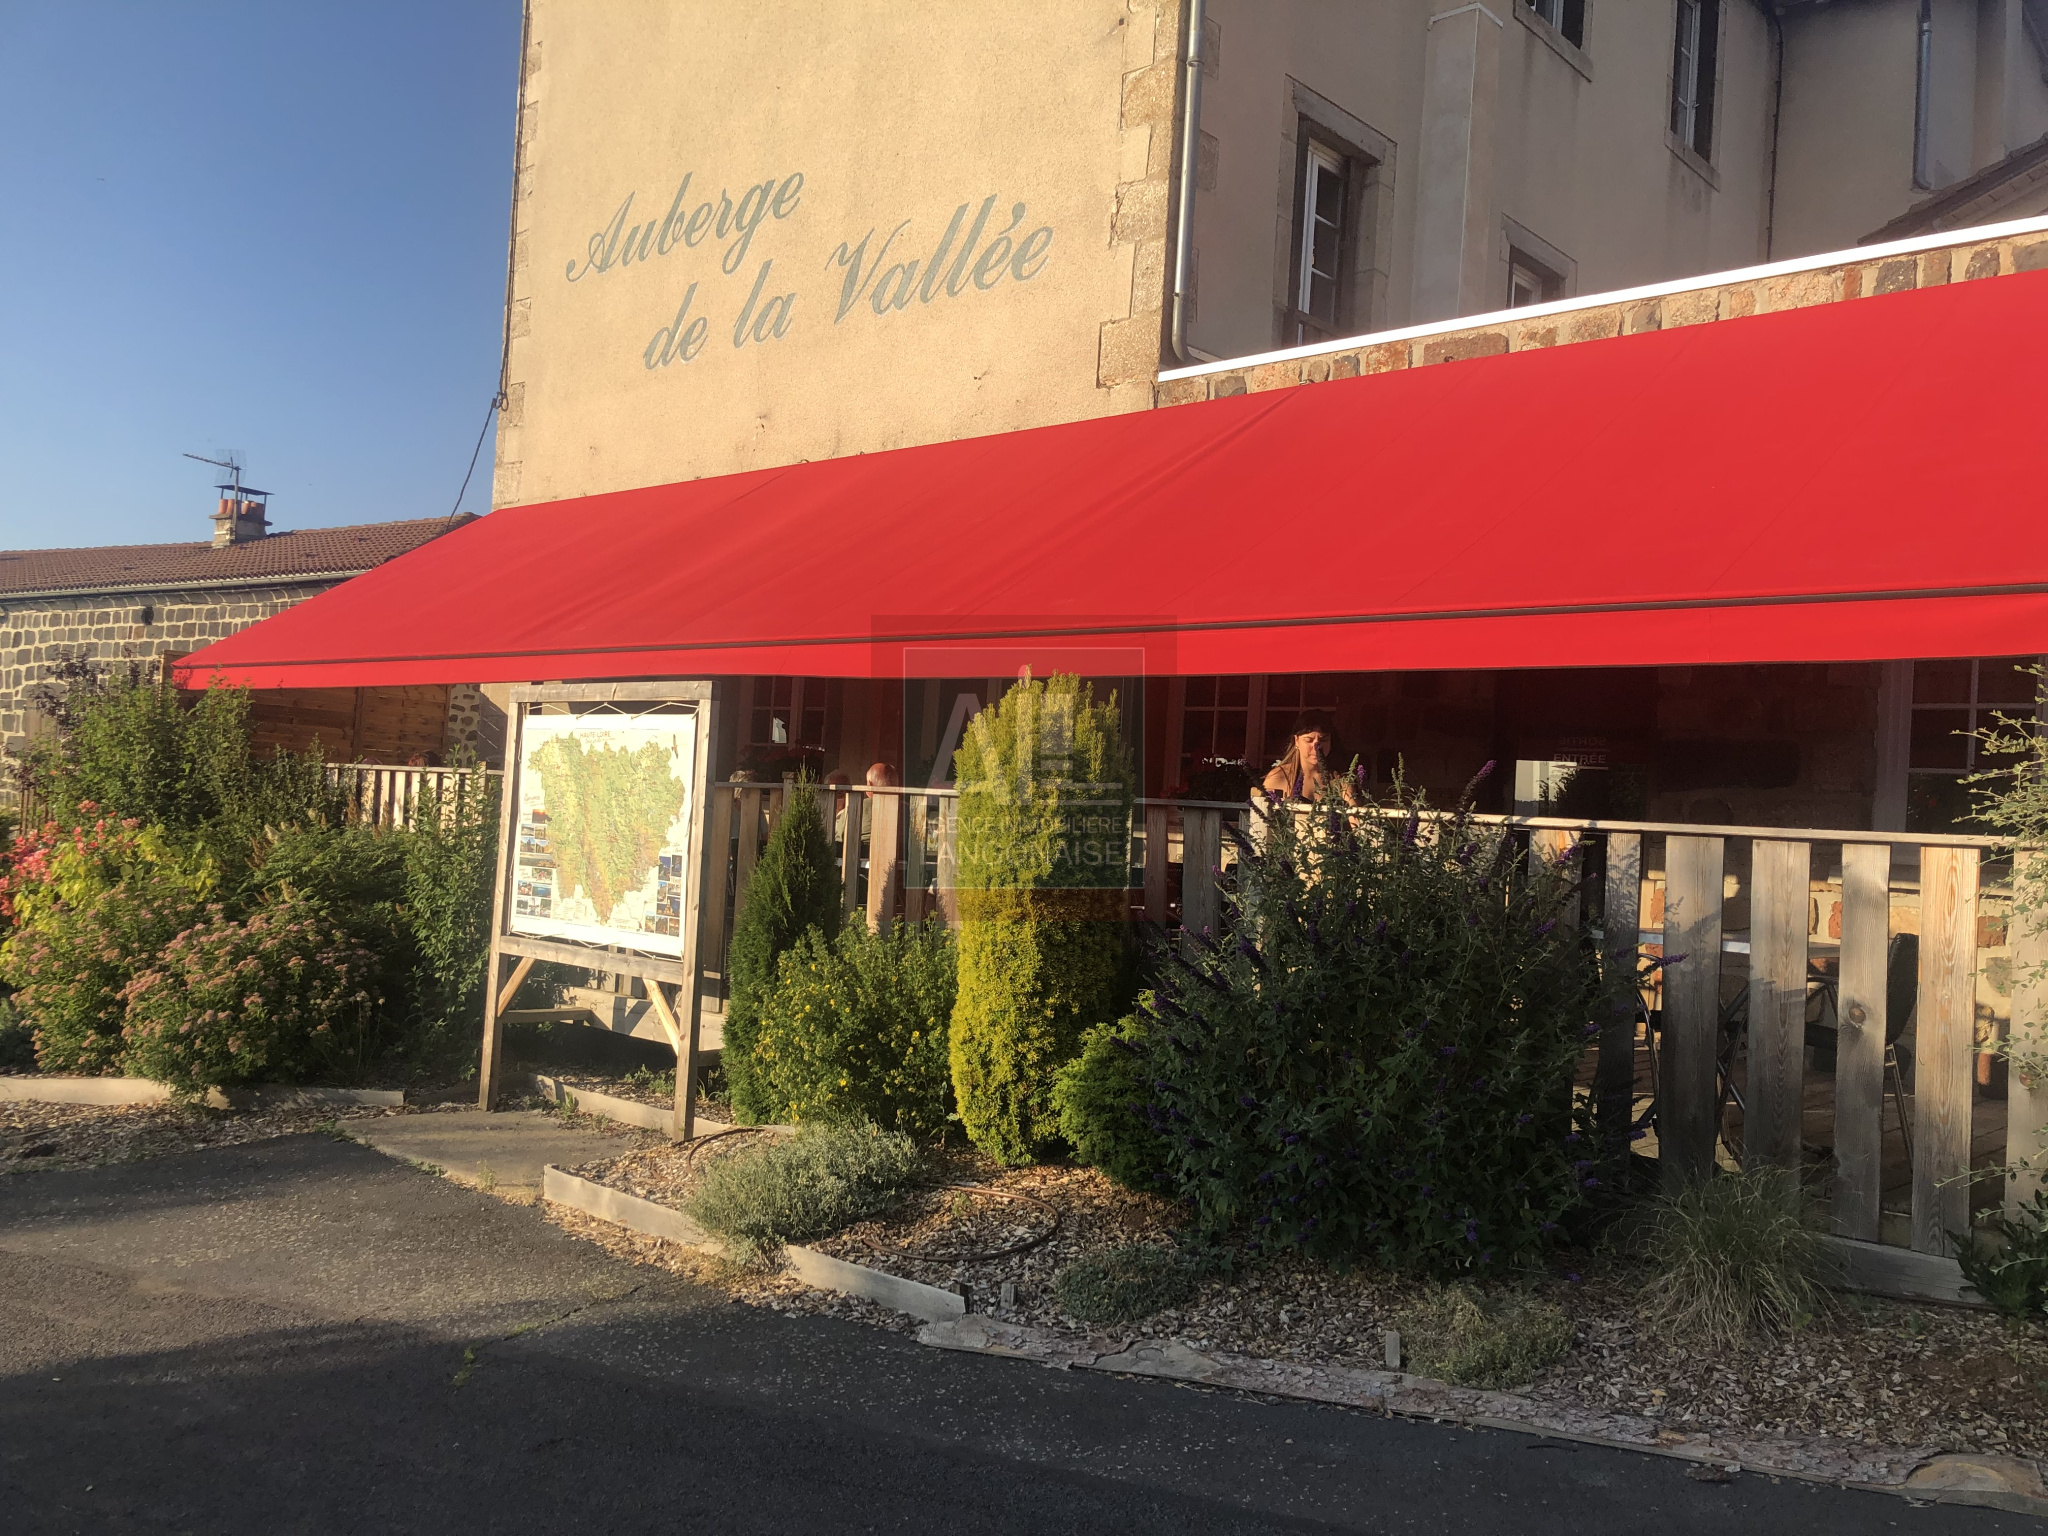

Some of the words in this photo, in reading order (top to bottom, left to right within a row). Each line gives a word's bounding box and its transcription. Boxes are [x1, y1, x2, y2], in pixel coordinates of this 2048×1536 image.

[566, 171, 804, 283] Auberge
[643, 281, 709, 370] de
[732, 258, 797, 349] la
[824, 193, 1054, 324] Vallée
[1553, 752, 1607, 764] ENTRÉE
